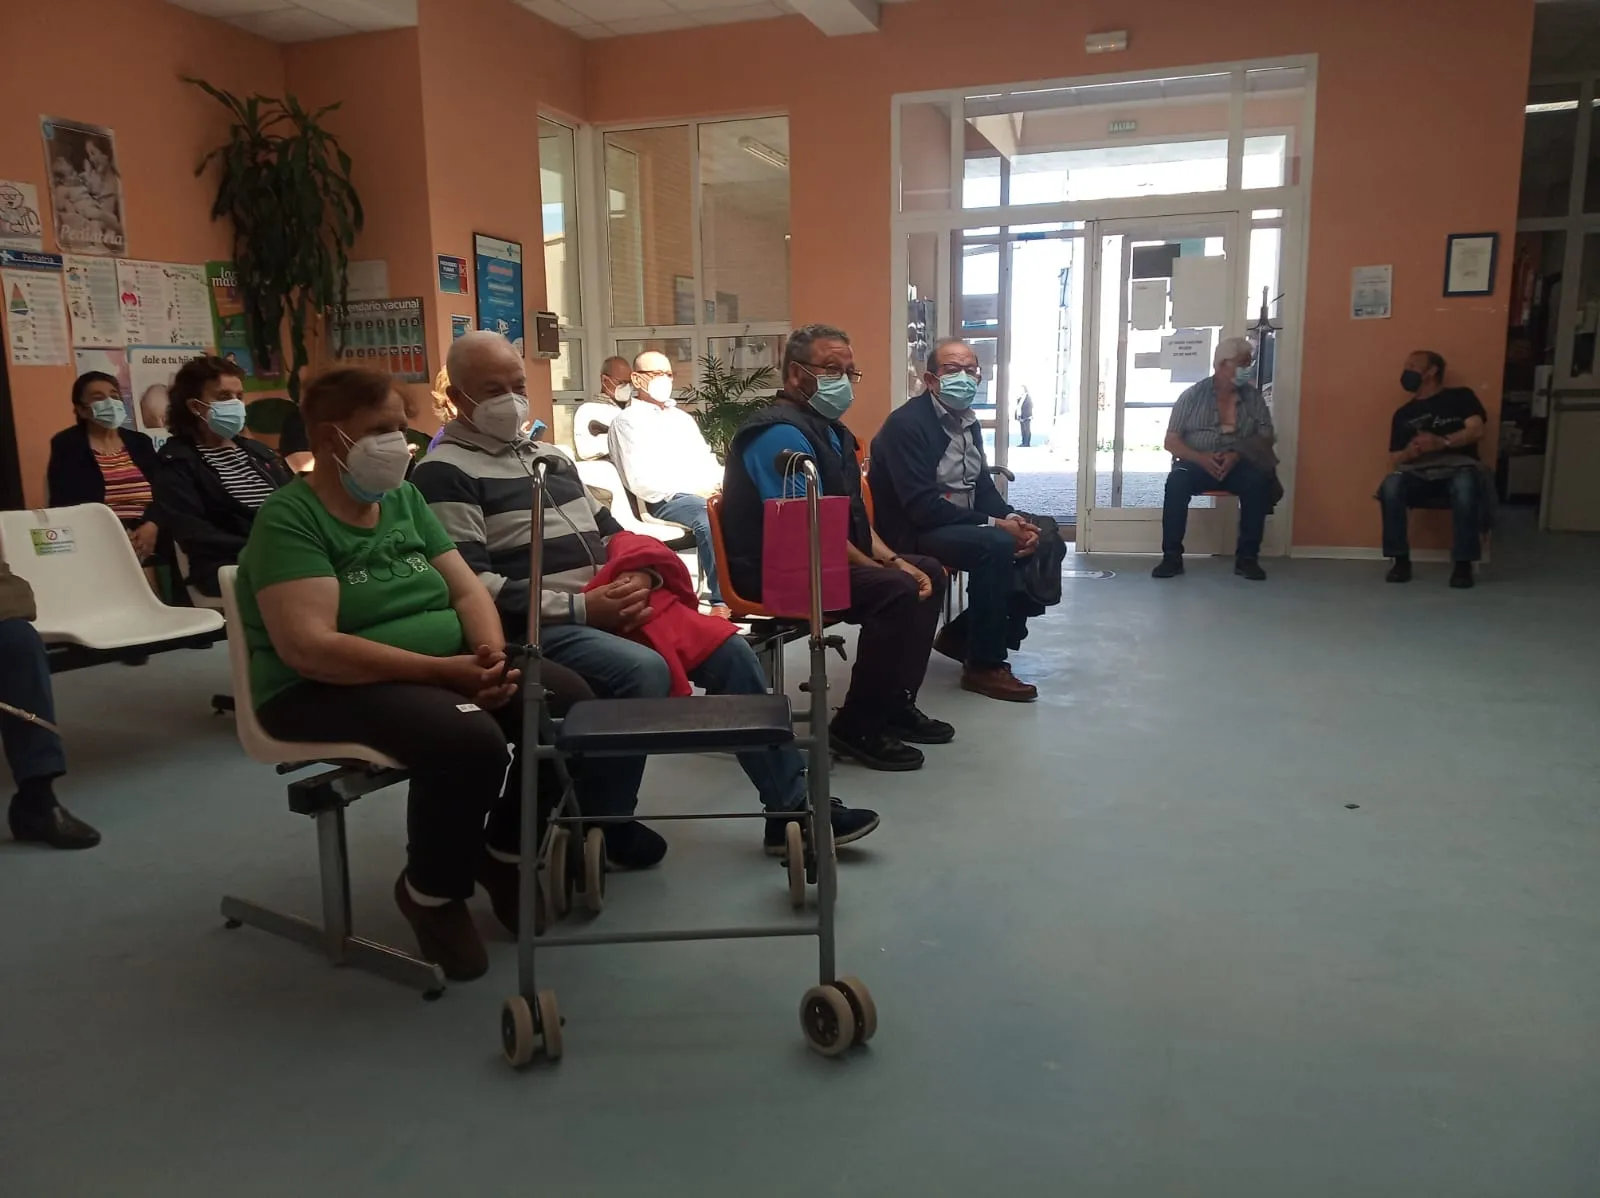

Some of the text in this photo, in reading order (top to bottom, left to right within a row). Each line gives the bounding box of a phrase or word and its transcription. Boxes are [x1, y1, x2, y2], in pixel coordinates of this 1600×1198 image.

[383, 298, 420, 311] vacunal
[142, 355, 160, 364] dale
[168, 356, 177, 364] tu
